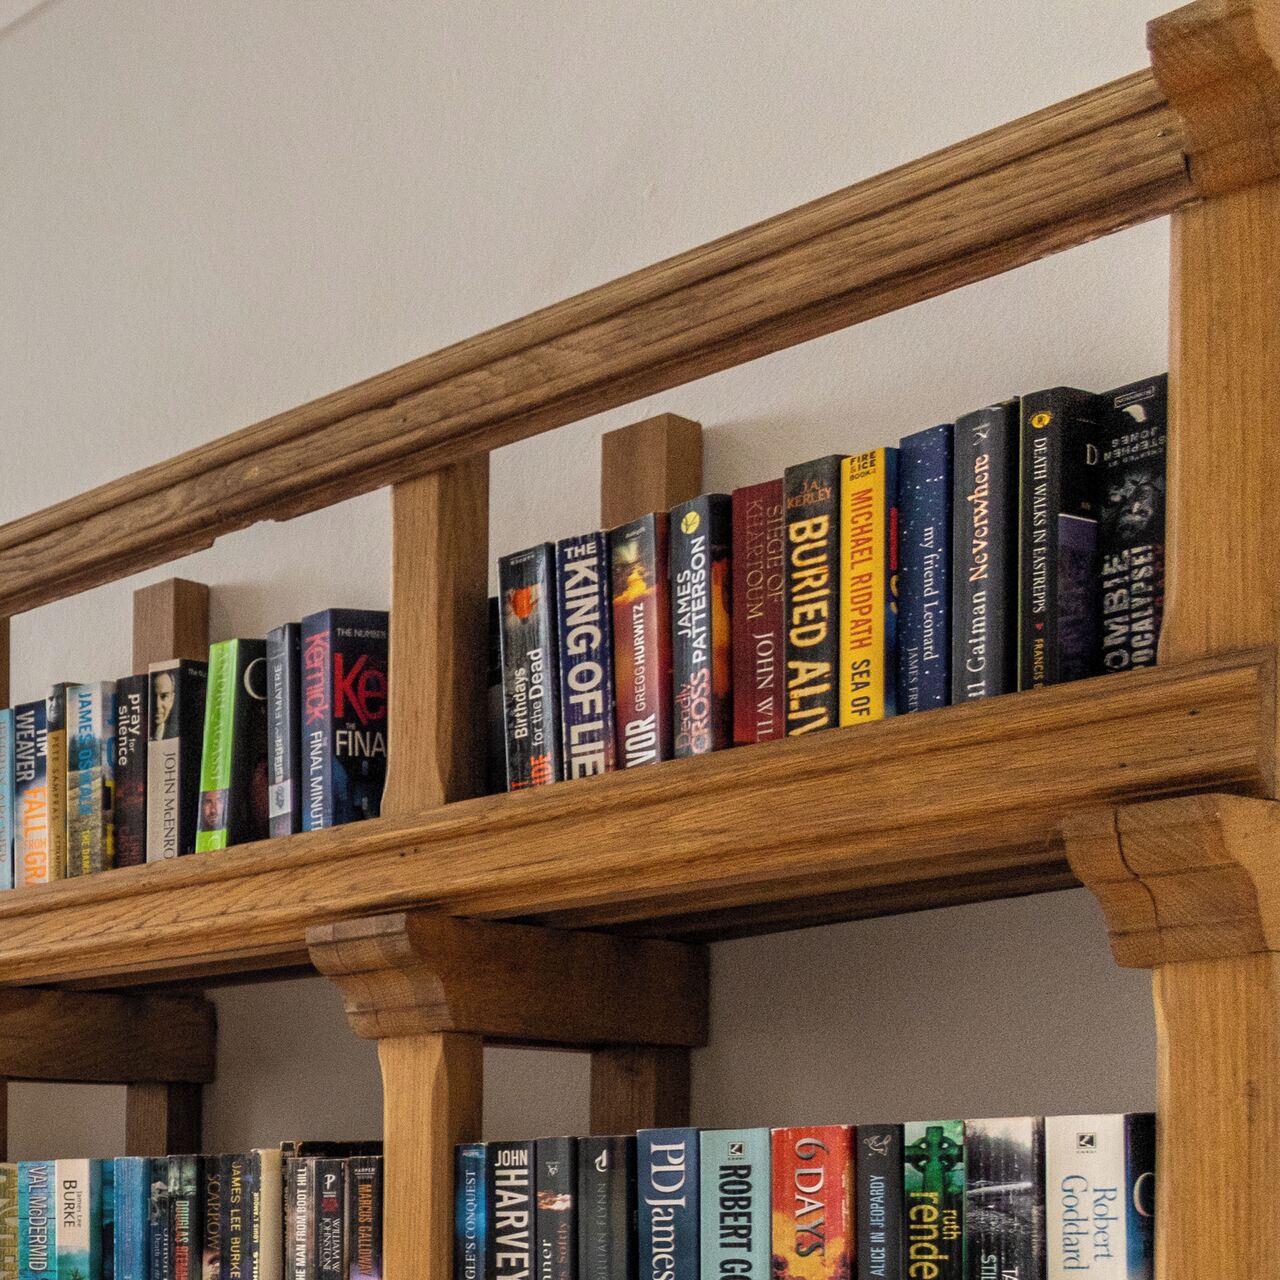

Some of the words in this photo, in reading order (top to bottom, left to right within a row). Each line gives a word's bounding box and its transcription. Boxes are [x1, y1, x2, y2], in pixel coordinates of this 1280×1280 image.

[1033, 438, 1047, 479] DEATH
[849, 488, 872, 569] MICHAEL
[968, 454, 989, 582] Neverwhere
[1033, 484, 1047, 525] WALKS
[564, 542, 597, 559] THE
[921, 527, 933, 550] my
[692, 536, 706, 664] PATTERSON
[788, 514, 830, 647] BURIED
[923, 552, 939, 596] friend
[564, 559, 601, 657] KING
[677, 570, 690, 637] JAMES
[849, 574, 872, 650] RIDPATH
[633, 603, 645, 668] HURWITZ
[923, 601, 938, 661] Leonard
[967, 591, 986, 672] Gaiman
[305, 630, 329, 726] Kernick
[527, 649, 542, 701] Dead
[756, 632, 773, 690] JOHN
[851, 659, 870, 690] SEA
[78, 693, 92, 738] JAMES
[129, 694, 140, 736] pray
[514, 667, 527, 739] Birthdays
[567, 662, 602, 716] OF
[16, 711, 35, 782] WEAVER
[37, 729, 48, 758] TIM
[118, 706, 129, 766] silence
[311, 730, 321, 775] FINAL
[164, 751, 175, 793] JOHN
[24, 786, 47, 838] FALL
[28, 1166, 47, 1192] VAL
[494, 1150, 528, 1167] JOHN
[63, 1179, 77, 1228] BURKE
[295, 1189, 307, 1212] BOOT
[295, 1214, 307, 1241] FROM
[465, 1170, 477, 1240] CONQUEST
[718, 1164, 752, 1252] ROBERT
[794, 1168, 825, 1257] DAYS
[871, 1175, 885, 1230] JEOPARDY
[942, 1210, 962, 1240] ruth
[1060, 1175, 1090, 1271] Goddard
[1093, 1186, 1118, 1263] Robert
[295, 1242, 307, 1264] MAN
[871, 1248, 885, 1276] ALICE
